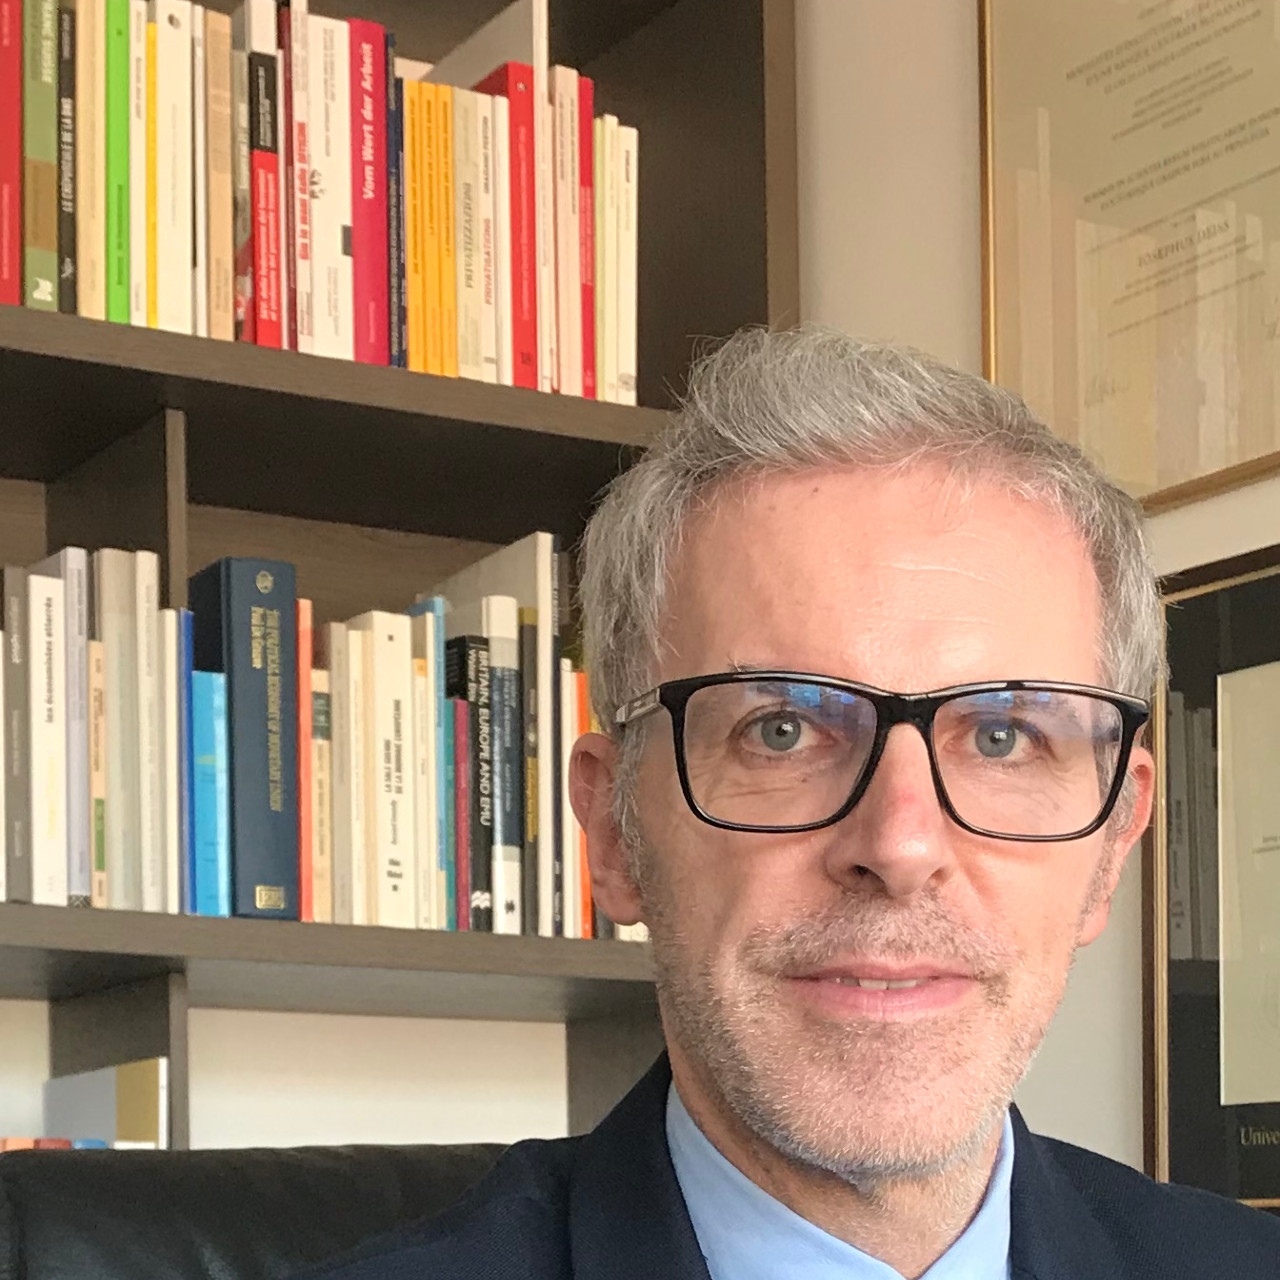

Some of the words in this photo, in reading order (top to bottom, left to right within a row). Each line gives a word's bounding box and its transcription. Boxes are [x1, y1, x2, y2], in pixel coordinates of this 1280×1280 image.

[359, 41, 374, 92] Arbeit
[360, 93, 374, 122] der
[361, 124, 374, 161] Wert
[362, 164, 375, 200] Vom
[462, 182, 474, 289] PRIVATIZZAZIONI
[42, 596, 55, 639] atterrés
[266, 608, 281, 628] THE
[42, 640, 55, 706] économistes
[467, 648, 478, 682] Walter
[477, 649, 491, 706] BRITAIN,
[478, 707, 491, 761] EUROPE
[479, 762, 491, 795] AND
[479, 796, 492, 826] EMU
